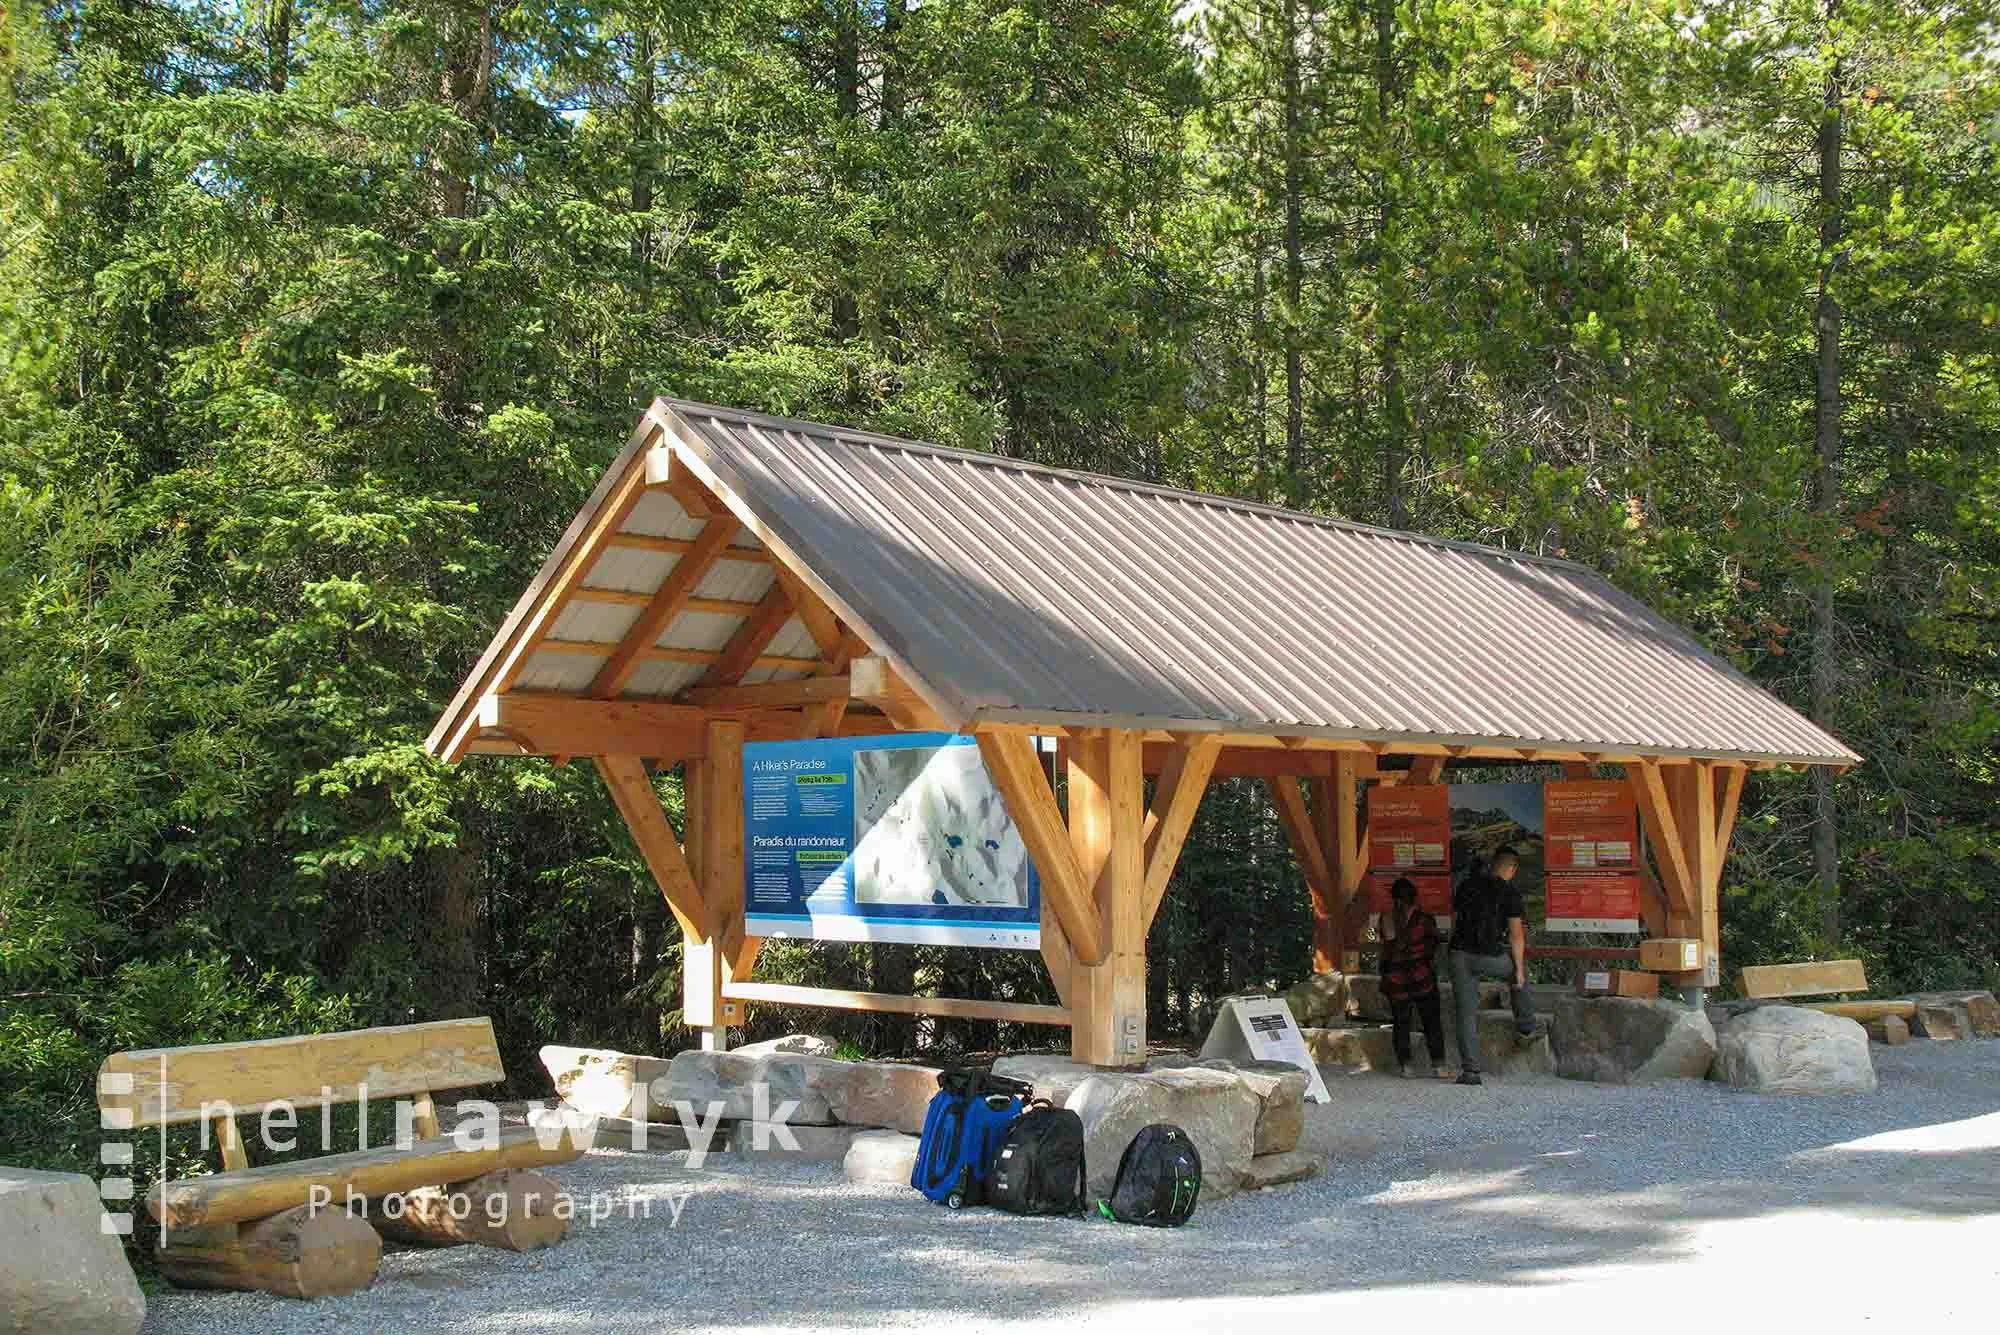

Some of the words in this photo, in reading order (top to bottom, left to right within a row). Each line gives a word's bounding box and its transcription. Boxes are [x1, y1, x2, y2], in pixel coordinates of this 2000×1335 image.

[753, 761, 760, 771] A
[761, 760, 789, 771] Hiker's
[790, 759, 827, 769] Paradise
[753, 835, 784, 847] Paradis
[785, 835, 797, 847] du
[798, 835, 845, 847] randonneur
